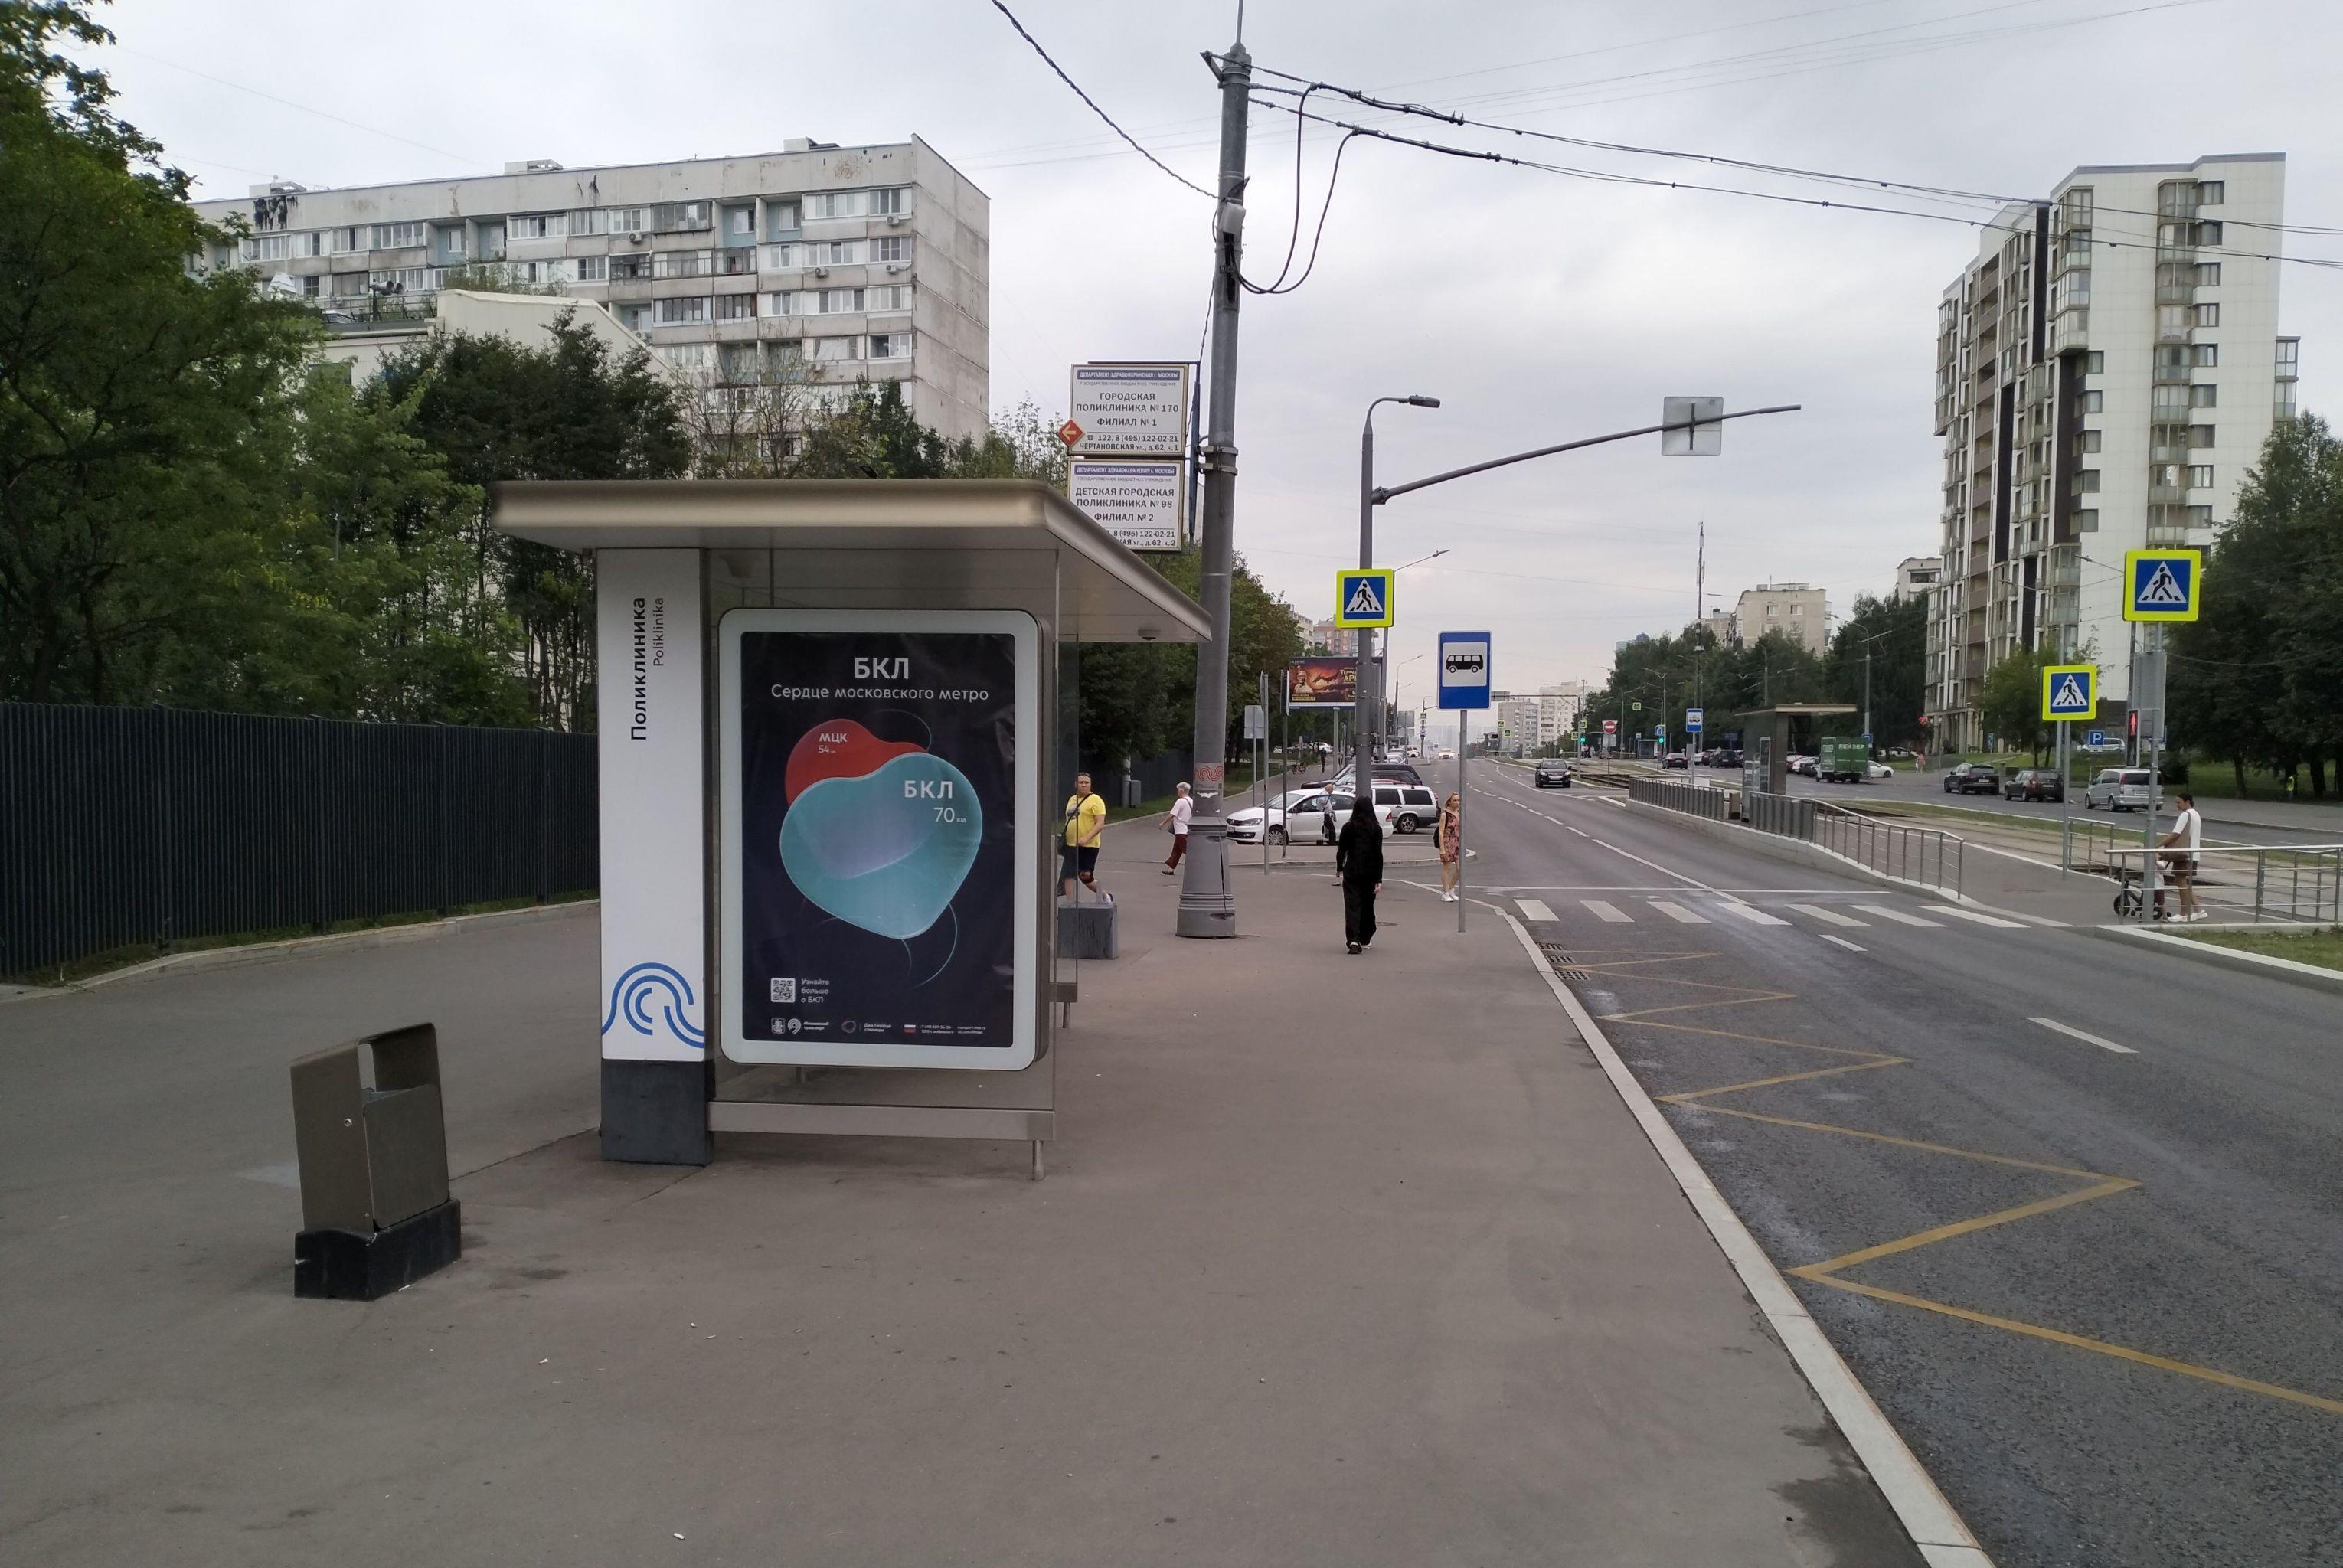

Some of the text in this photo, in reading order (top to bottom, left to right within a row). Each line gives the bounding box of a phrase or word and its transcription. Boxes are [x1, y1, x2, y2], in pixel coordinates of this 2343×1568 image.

[1100, 393, 1155, 401] ГОРОДСКАЯ
[1097, 418, 1137, 426] ФИЛИАЛ
[1075, 488, 1175, 497] ДЕТСКАЯ ГОРОДСКАЯ
[1094, 513, 1134, 521] ФИЛИАЛ
[652, 598, 664, 666] Poliklinika
[631, 598, 647, 740] Поликлиника
[854, 657, 910, 679] БКЛ
[771, 684, 989, 703] Сердце московского метро
[819, 733, 848, 744] МЦК
[2093, 732, 2102, 744] P
[818, 744, 829, 753] 54
[904, 779, 953, 799] БКЛ
[933, 806, 955, 823] 70
[801, 978, 830, 986] Узнайте
